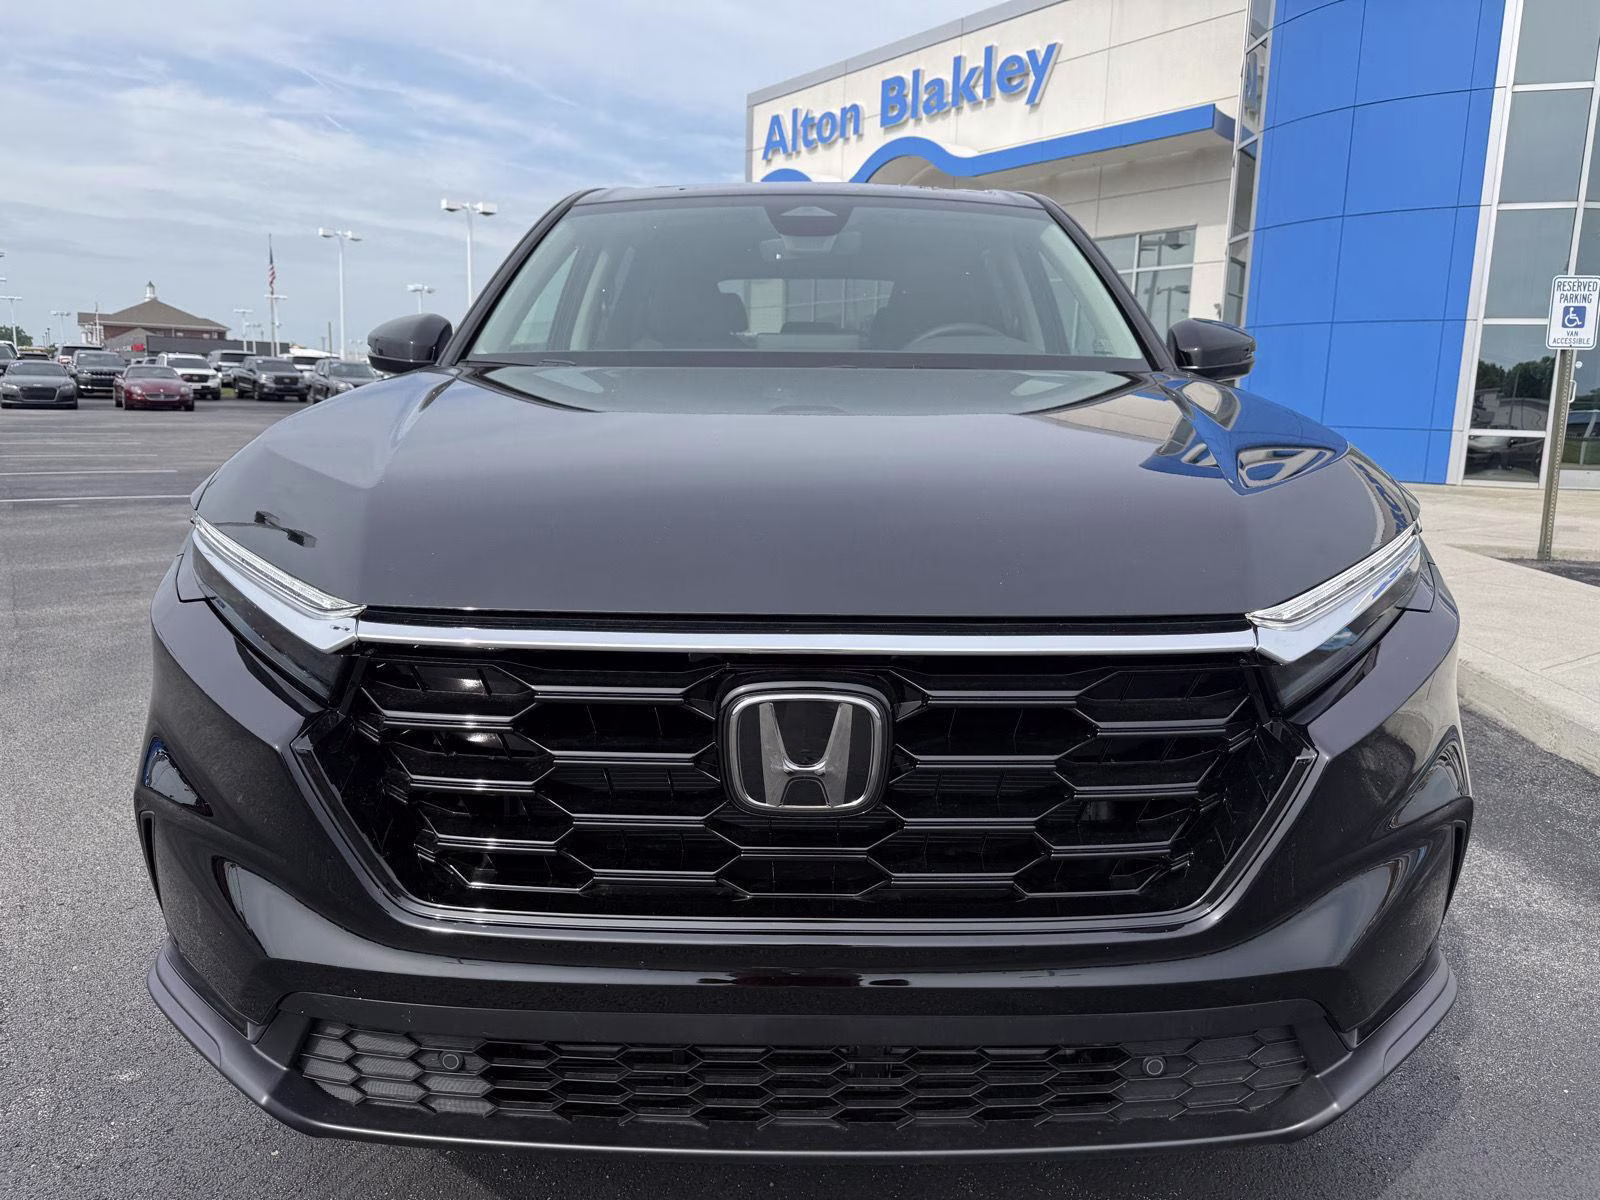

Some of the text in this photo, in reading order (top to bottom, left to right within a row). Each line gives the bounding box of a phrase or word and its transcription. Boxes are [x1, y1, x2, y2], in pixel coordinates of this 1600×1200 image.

[762, 42, 1062, 162] Alton Blakley
[1556, 280, 1598, 292] RESERVED
[1559, 293, 1593, 304] PARKING
[1552, 337, 1591, 345] ACCESSIBLE
